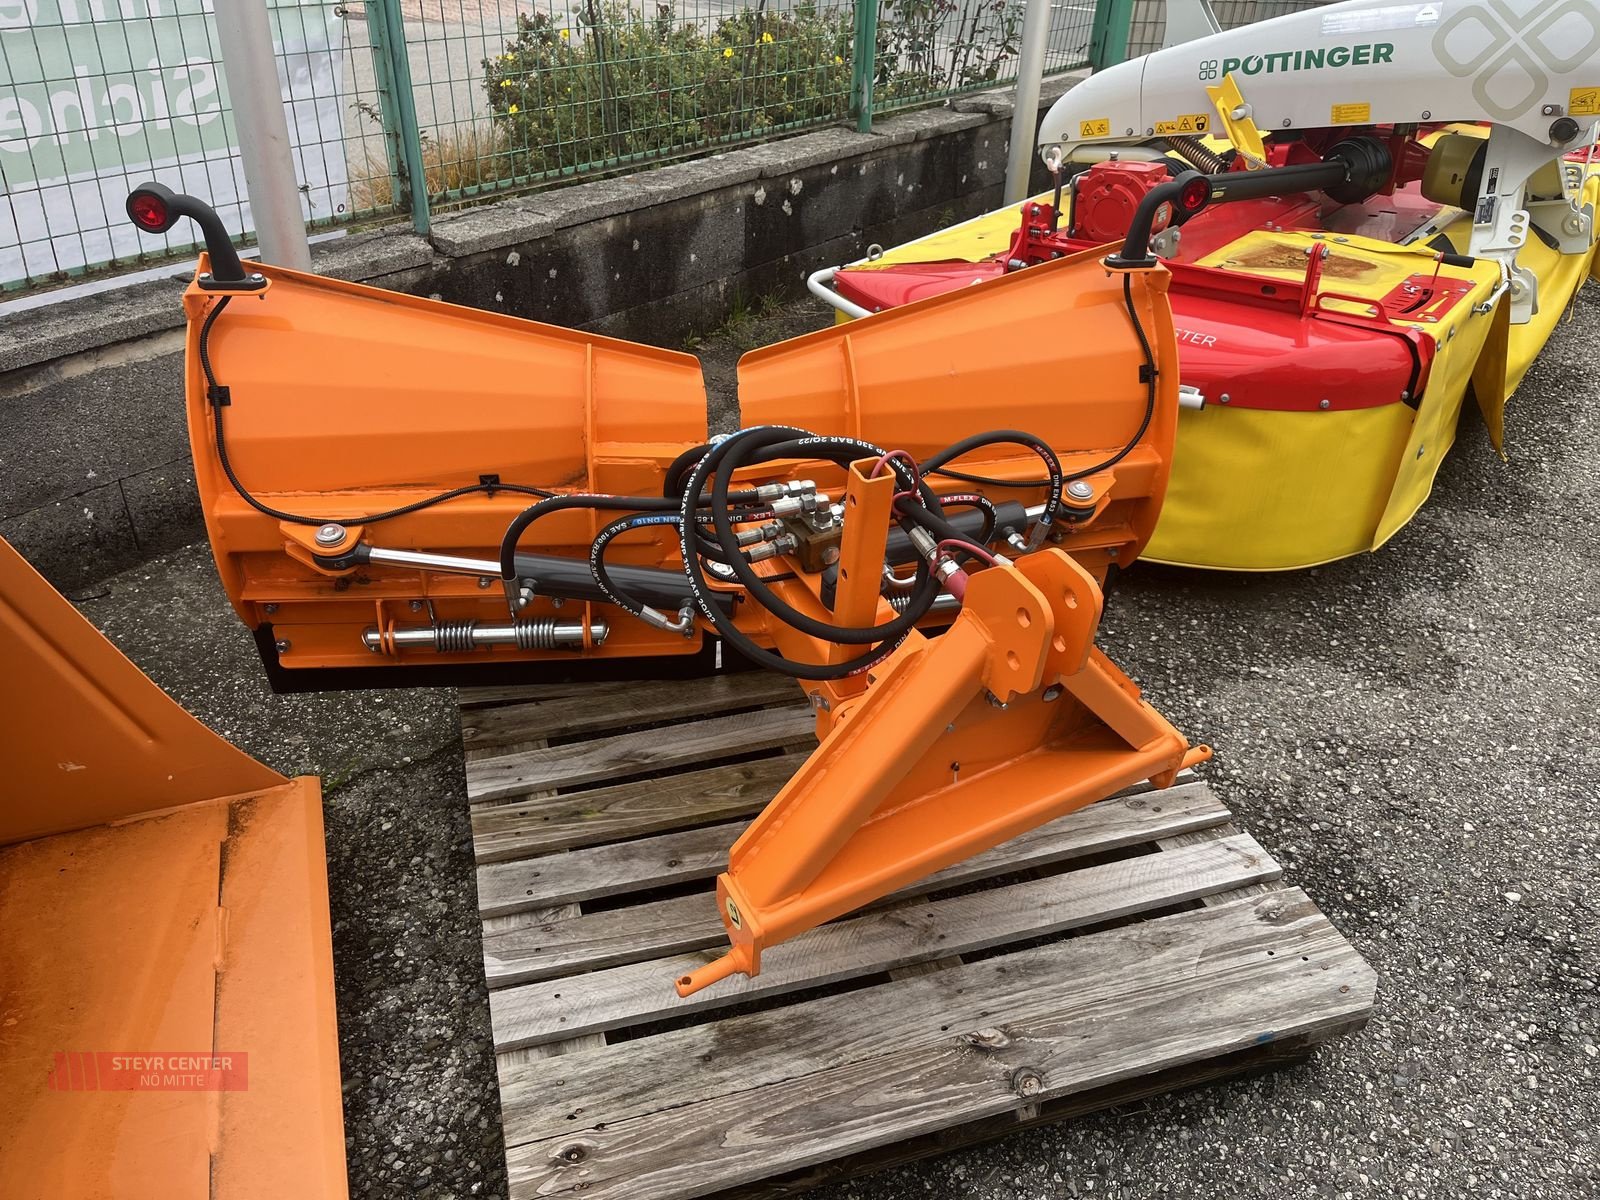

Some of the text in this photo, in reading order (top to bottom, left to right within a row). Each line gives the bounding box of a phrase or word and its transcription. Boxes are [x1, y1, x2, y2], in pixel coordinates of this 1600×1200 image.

[1221, 42, 1395, 77] PÖTTINGER
[830, 436, 854, 444] BAR
[856, 440, 873, 450] 330
[686, 472, 697, 488] 100
[609, 522, 627, 533] SAE
[599, 532, 611, 544] 100
[688, 576, 700, 598] BAR
